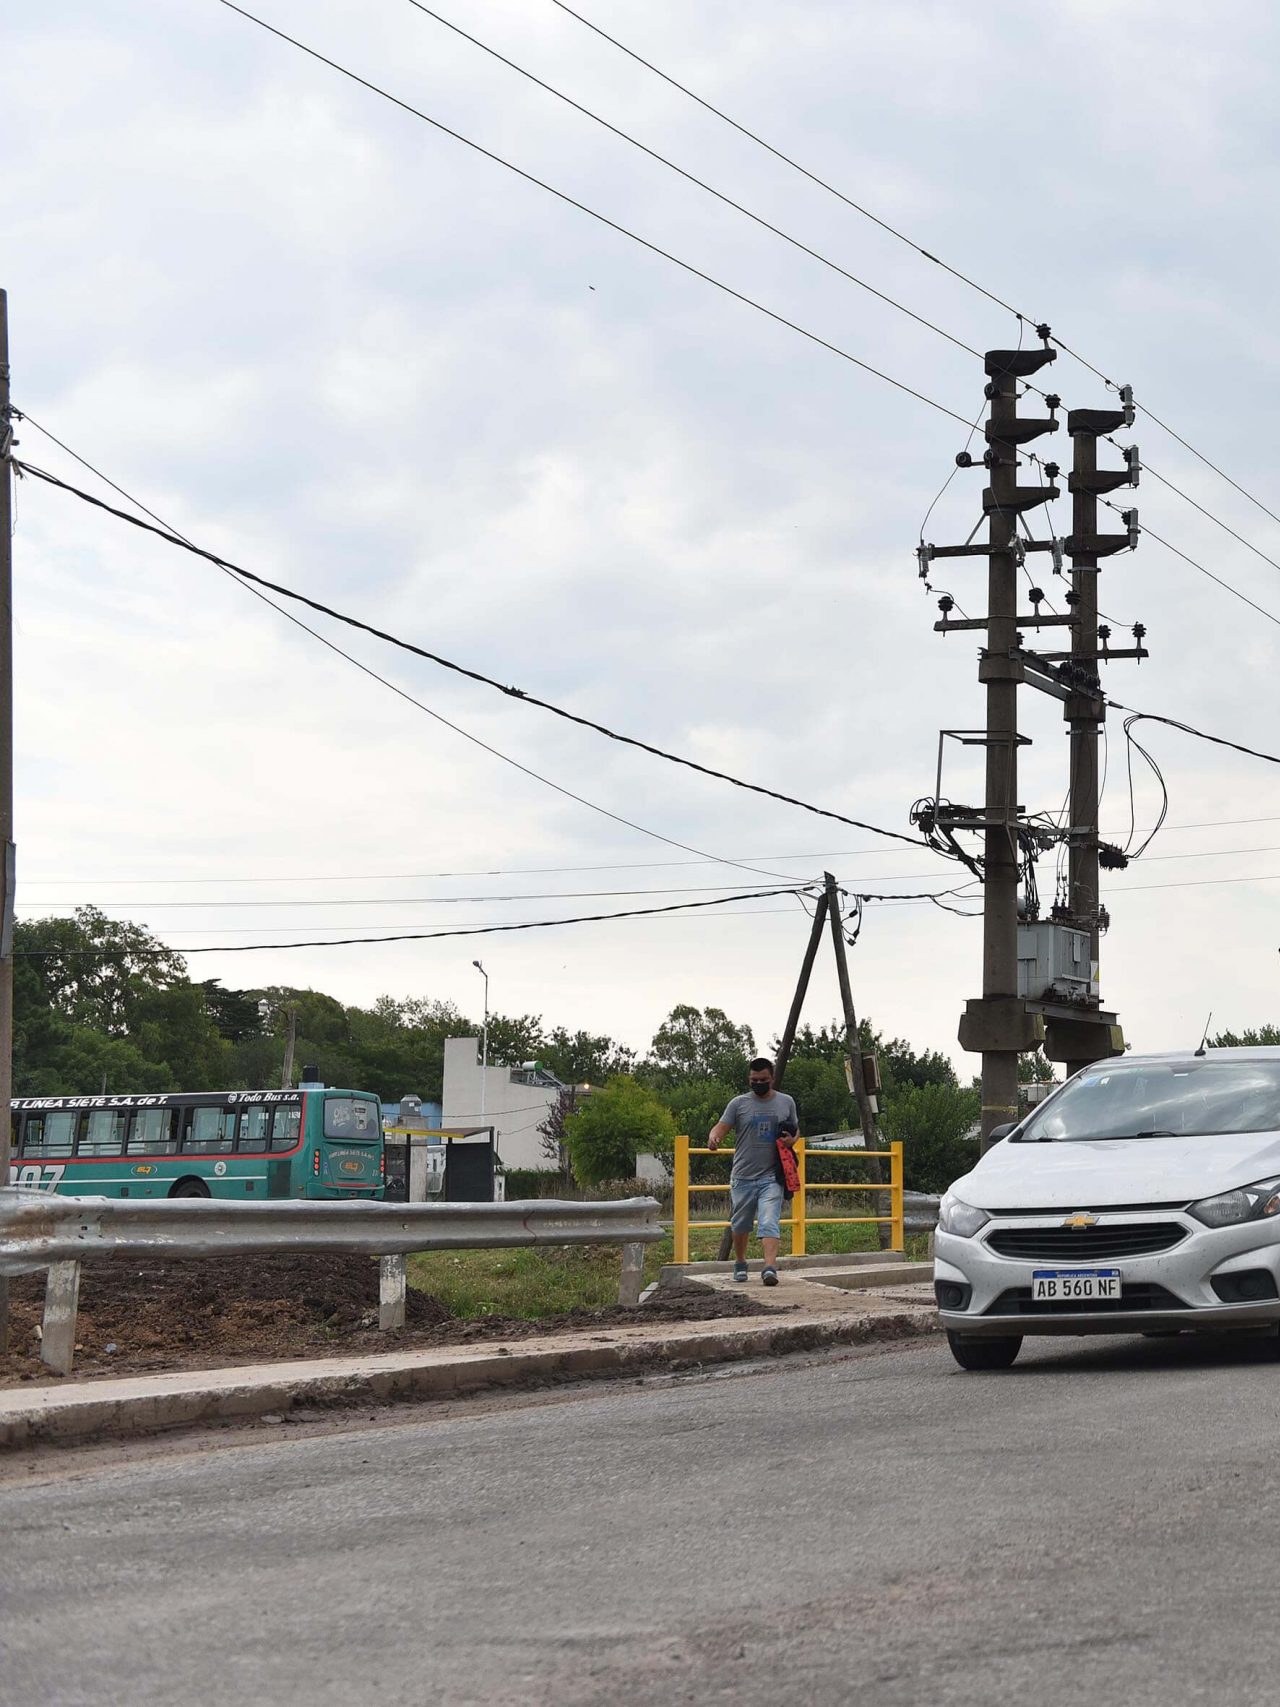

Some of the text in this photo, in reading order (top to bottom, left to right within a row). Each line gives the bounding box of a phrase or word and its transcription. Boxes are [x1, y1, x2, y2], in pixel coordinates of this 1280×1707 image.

[21, 1099, 64, 1109] LINEA
[66, 1098, 105, 1107] SIETE
[108, 1097, 135, 1106] S.A.
[136, 1097, 156, 1105] de
[238, 1093, 262, 1102] Todo
[263, 1092, 281, 1102] Bus
[1037, 1279, 1117, 1297] AB 560 NF
